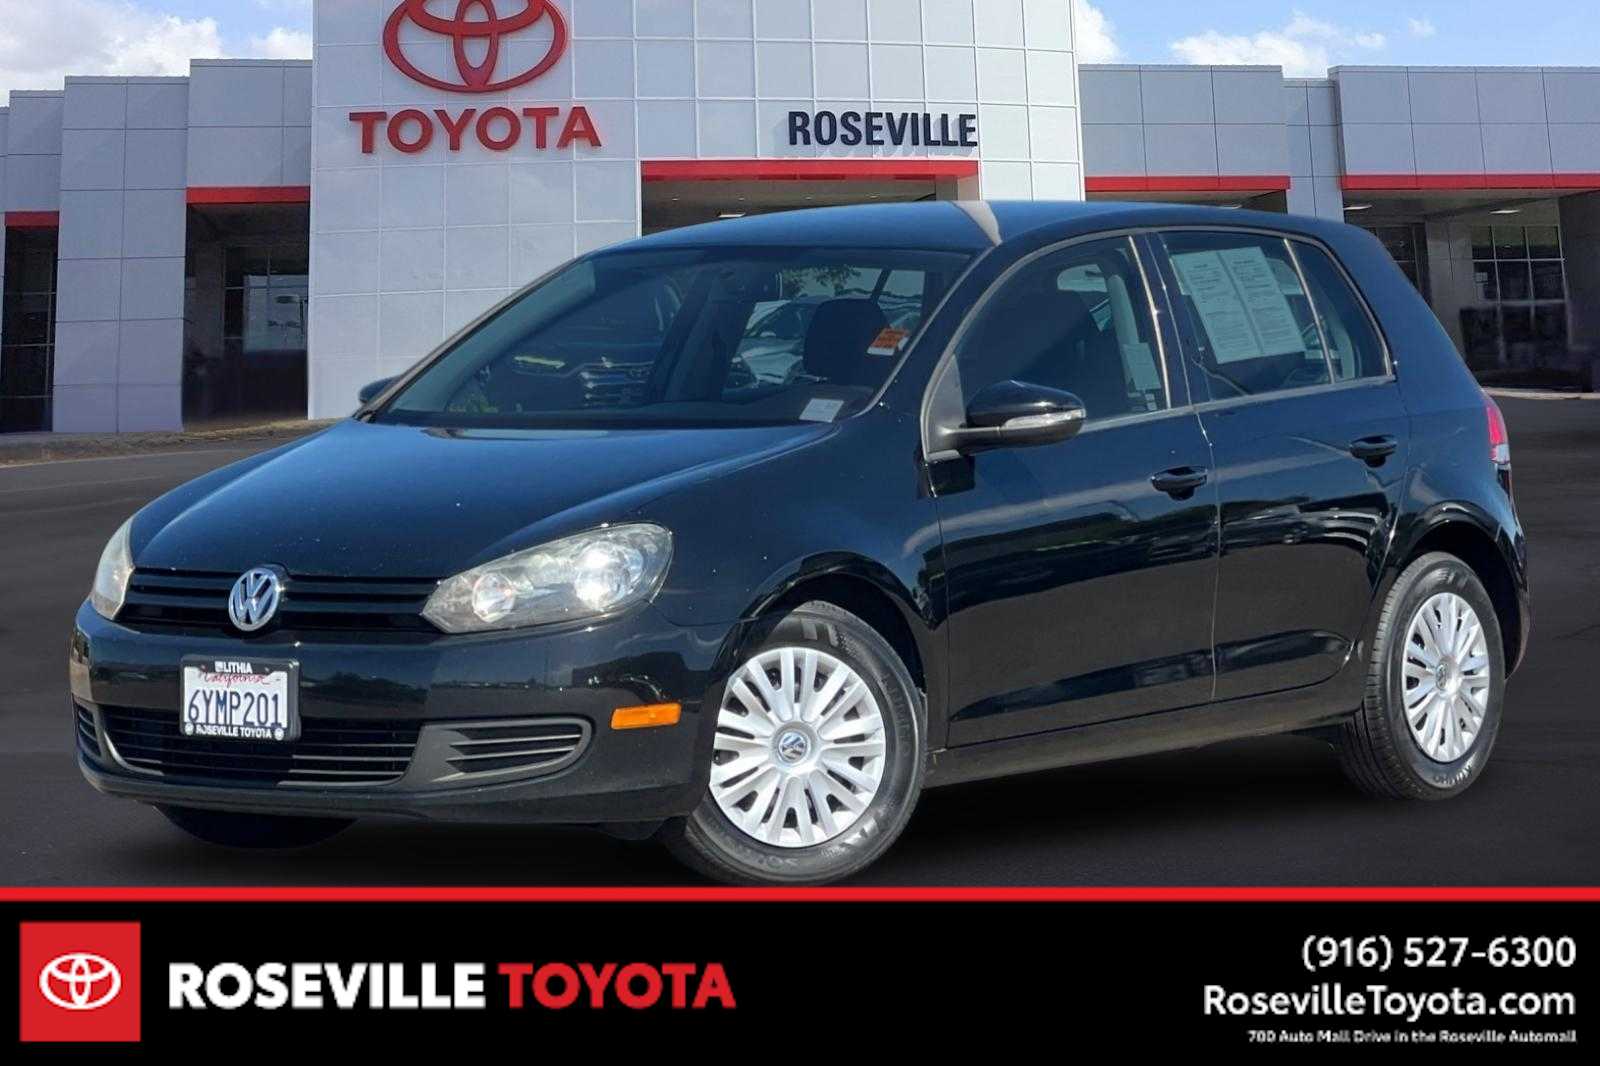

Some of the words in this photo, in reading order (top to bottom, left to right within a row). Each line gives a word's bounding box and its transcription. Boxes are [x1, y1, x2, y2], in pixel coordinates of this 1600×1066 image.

[349, 106, 602, 153] TOYOTA
[788, 110, 977, 147] ROSEVILLE
[223, 661, 253, 674] LITHIA
[188, 690, 282, 726] 6YMP201
[196, 724, 239, 737] ROSEVILLE
[240, 727, 272, 739] TOYOTA
